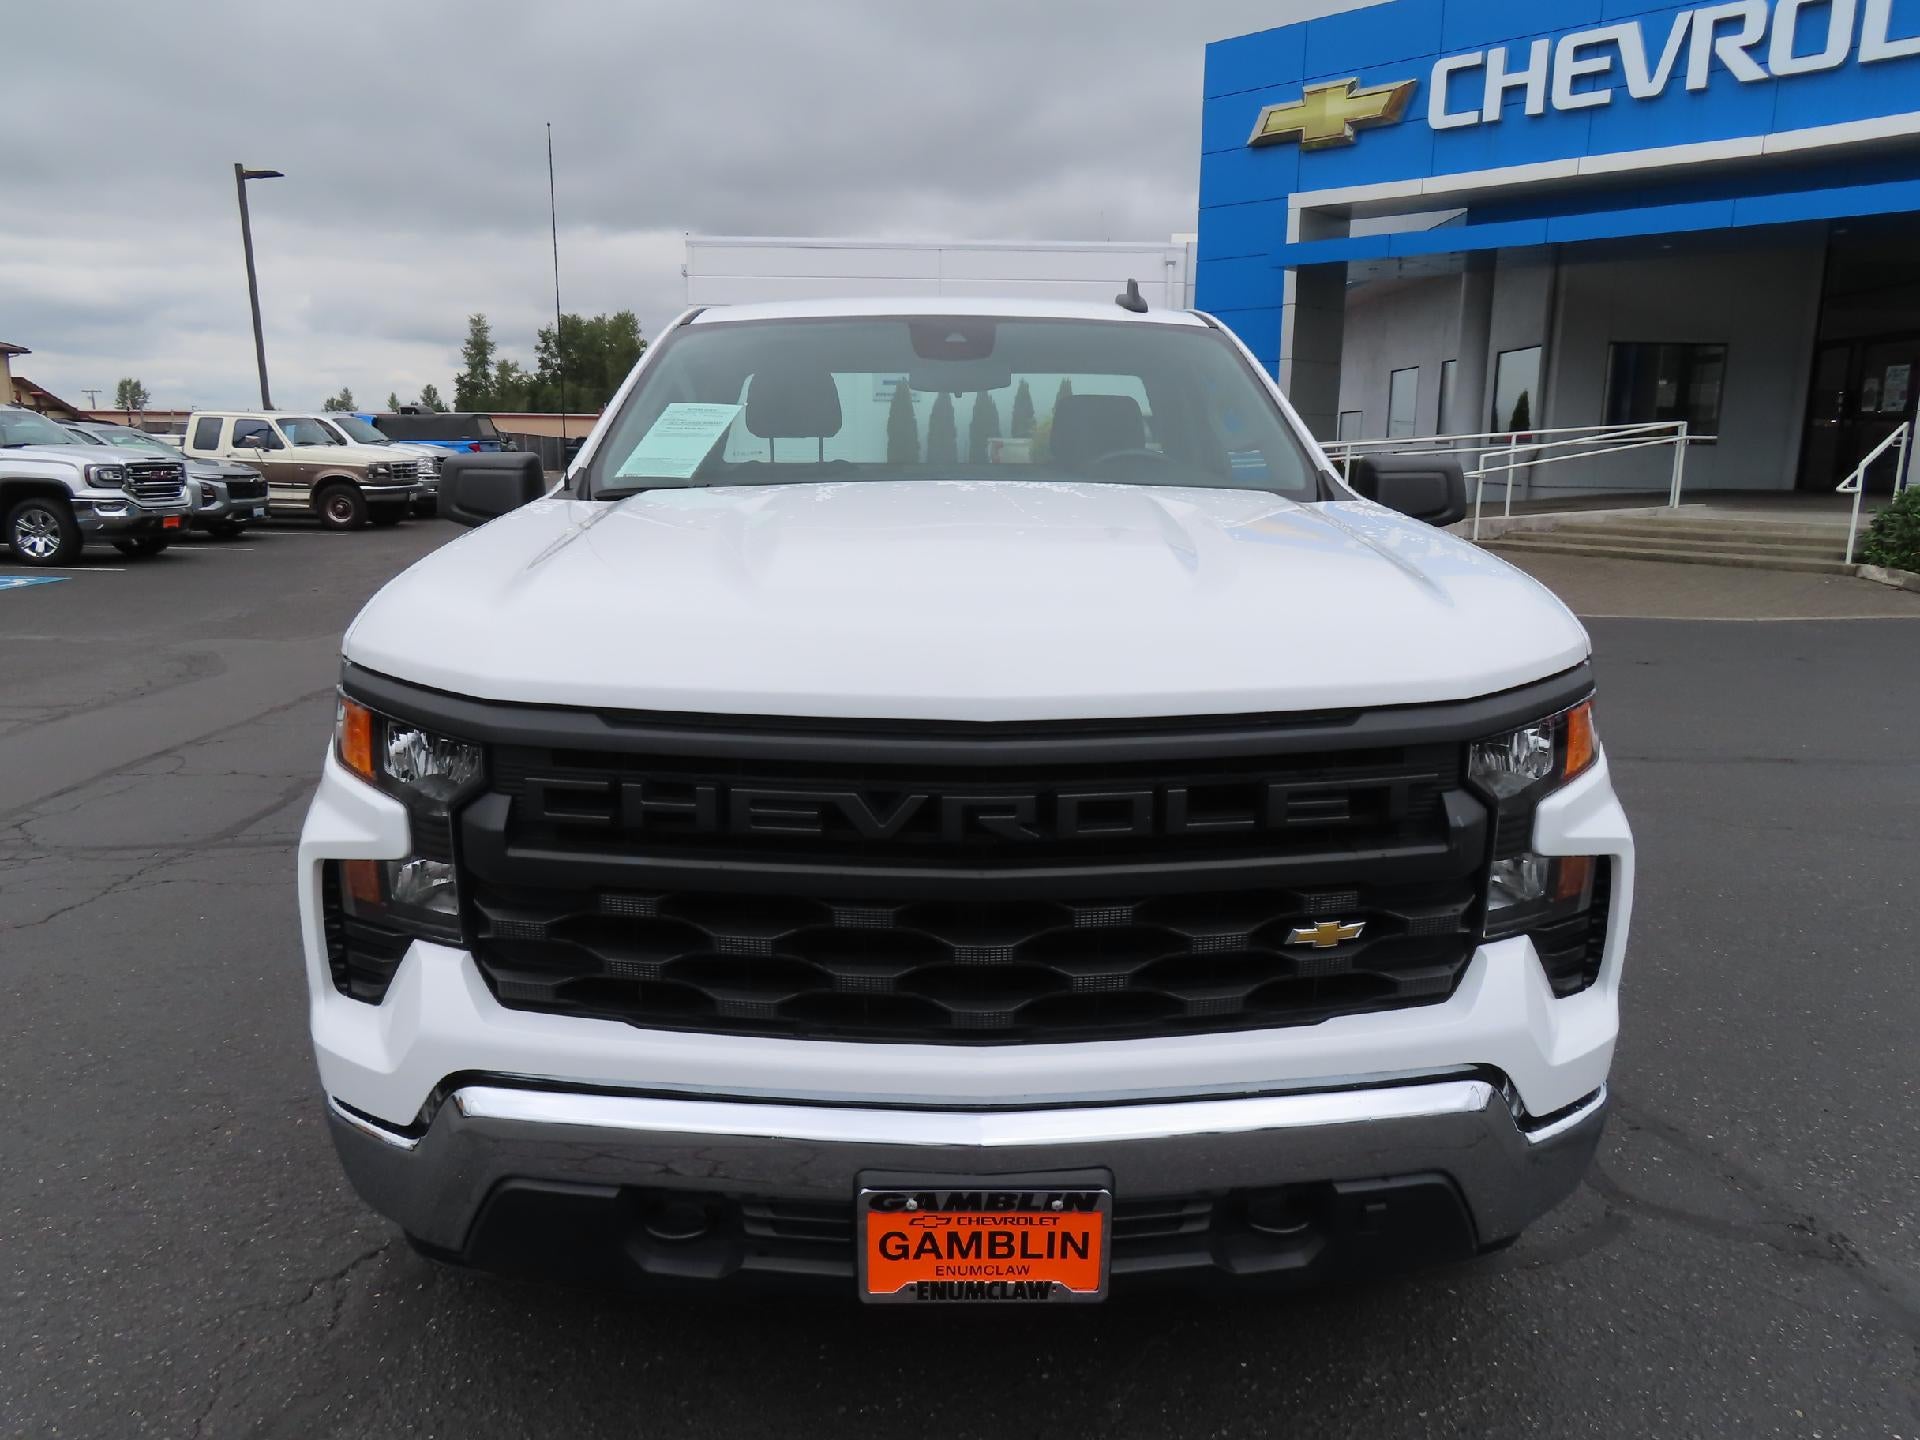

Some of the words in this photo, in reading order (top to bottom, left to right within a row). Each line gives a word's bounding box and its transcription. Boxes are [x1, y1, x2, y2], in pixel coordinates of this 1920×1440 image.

[1428, 0, 1920, 130] CHEVROL
[524, 773, 1438, 839] CHEVROLET
[869, 1191, 1099, 1213] GAMBLIN
[956, 1216, 1060, 1226] CHEVROLET
[878, 1230, 1090, 1261] GAMBLIN
[935, 1264, 1030, 1277] ENUMCLAW
[916, 1280, 1053, 1301] ENUMCLAW
